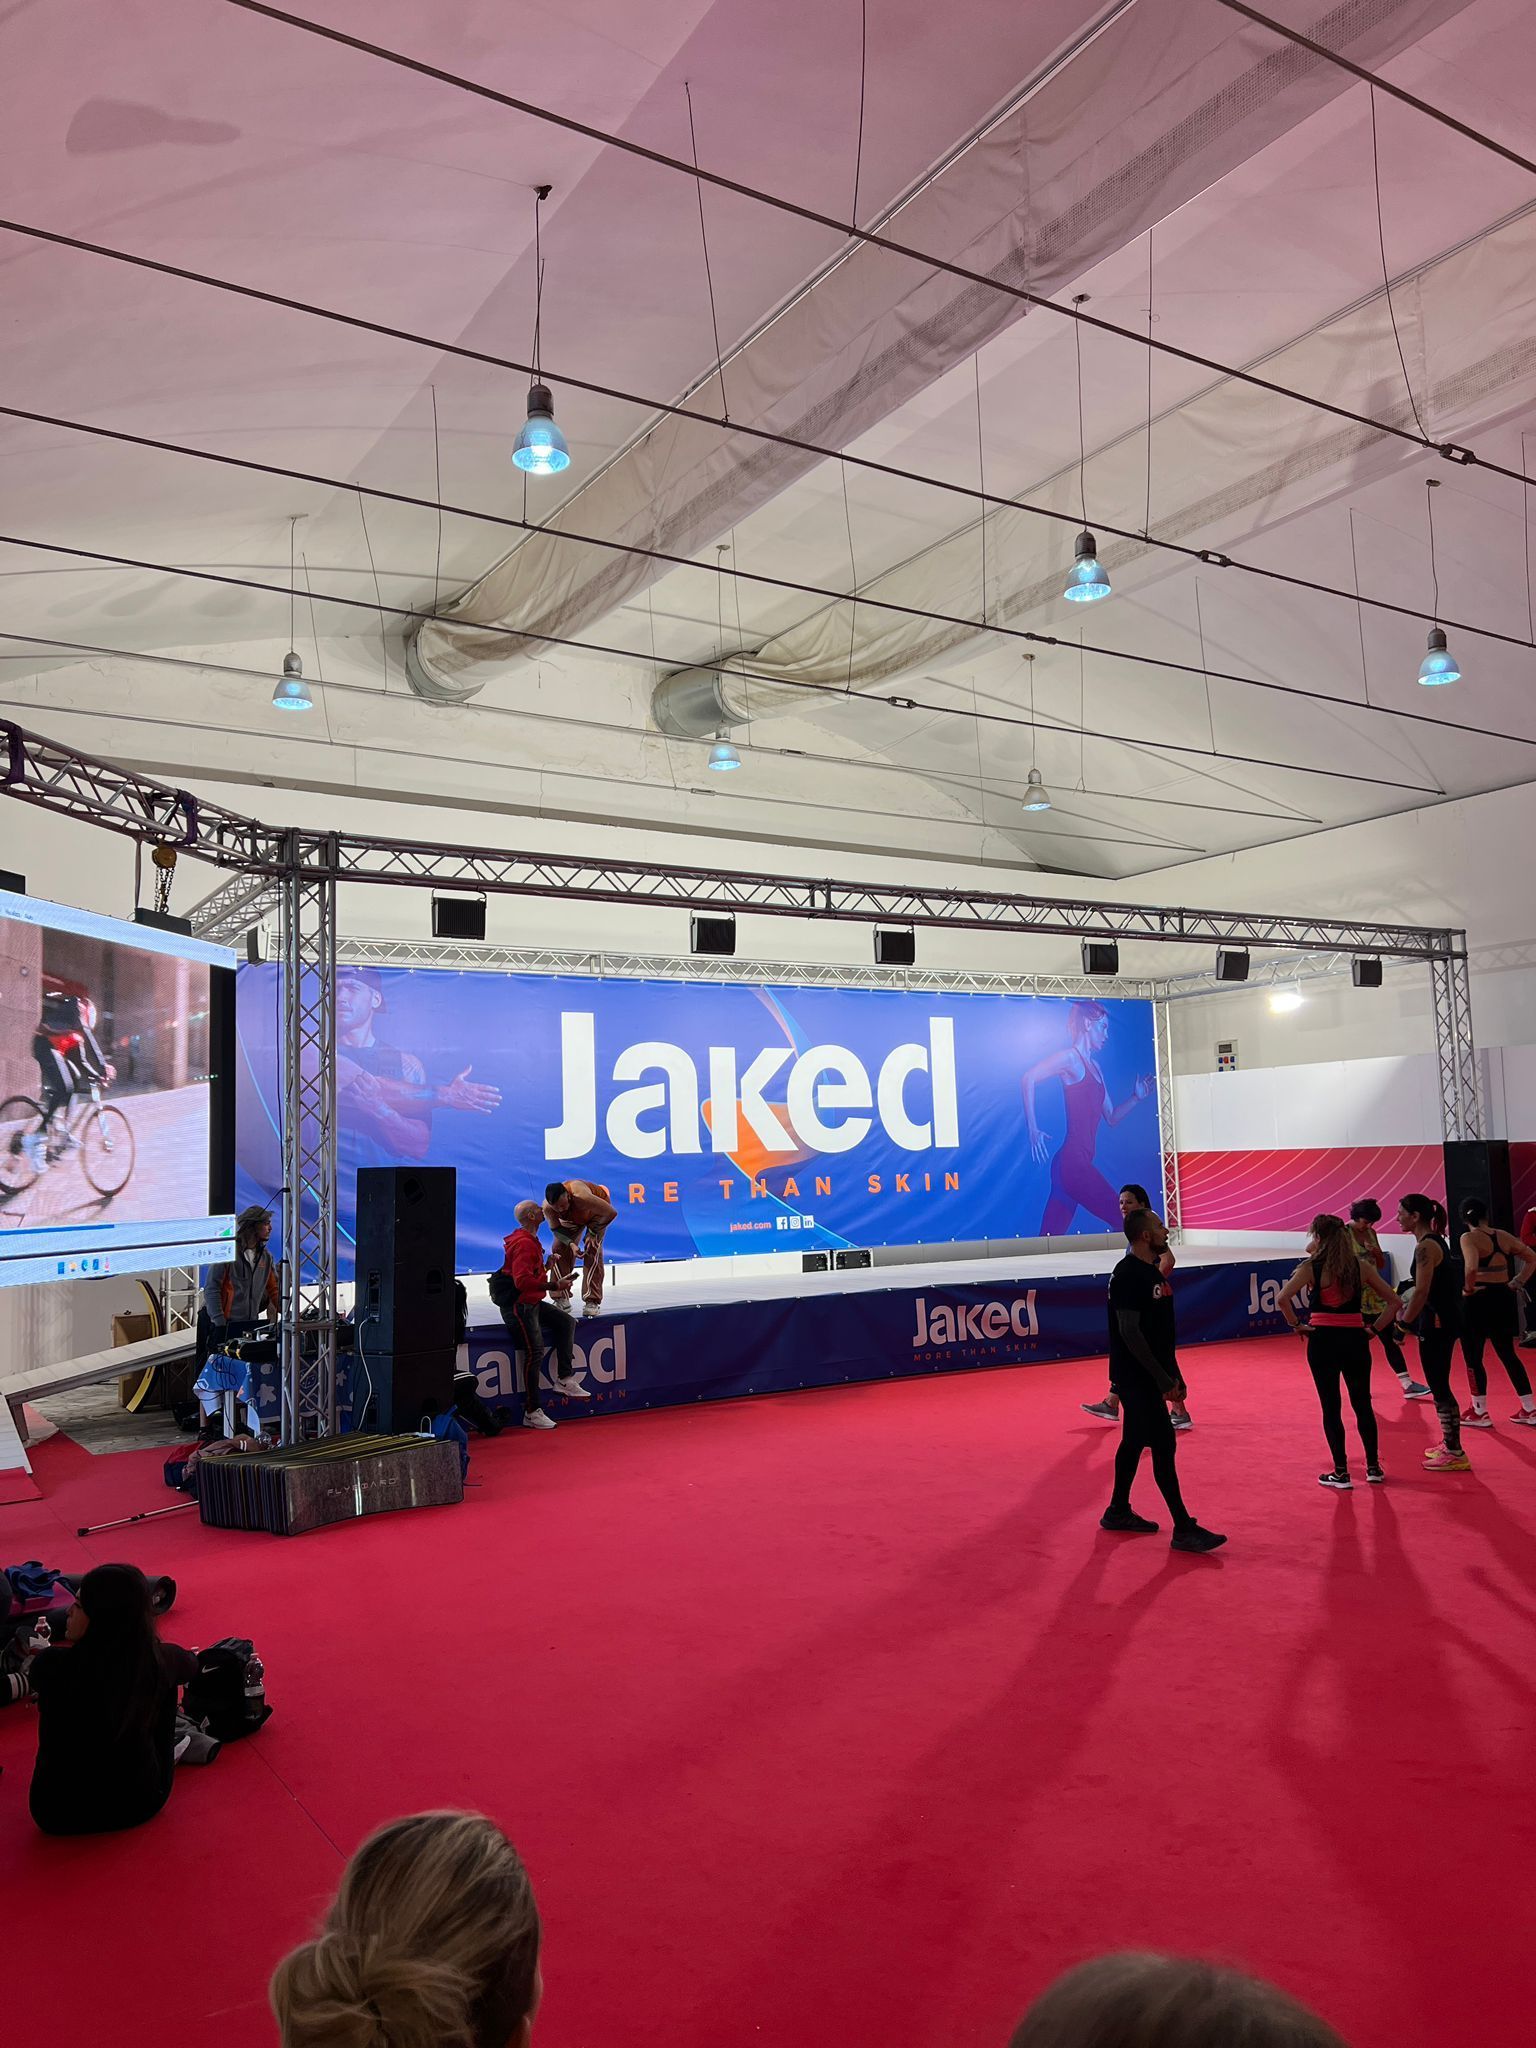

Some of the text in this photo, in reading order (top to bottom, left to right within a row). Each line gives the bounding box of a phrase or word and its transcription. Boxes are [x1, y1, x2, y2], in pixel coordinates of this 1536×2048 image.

[544, 1011, 960, 1161] Jaked
[598, 1172, 959, 1204] RE THAN SKIN
[730, 1221, 772, 1232] jaked.com
[913, 1289, 1039, 1347] Jaked
[914, 1343, 1037, 1361] MORE THAN SKIN
